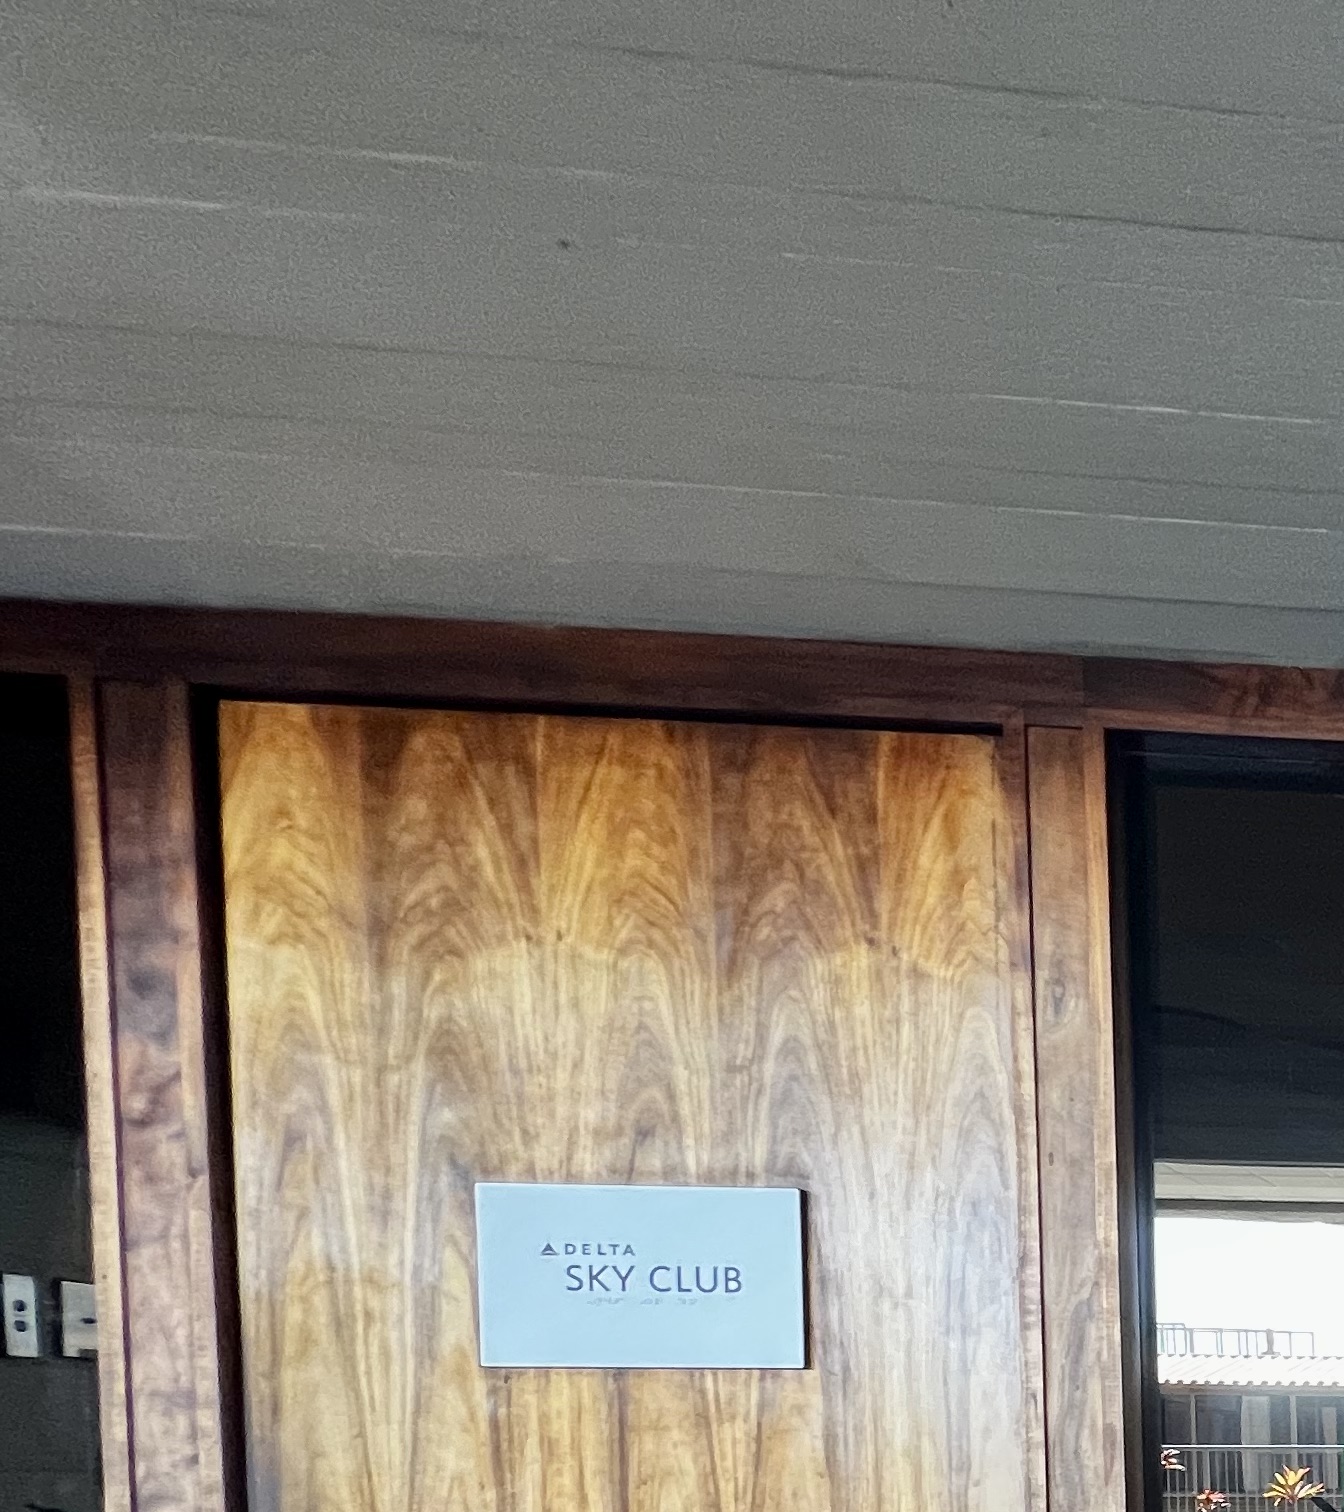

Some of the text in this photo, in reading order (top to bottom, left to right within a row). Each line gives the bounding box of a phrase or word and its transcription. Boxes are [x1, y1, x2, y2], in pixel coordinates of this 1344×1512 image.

[564, 1243, 636, 1256] DELTA
[566, 1264, 742, 1294] SKY CLUB
